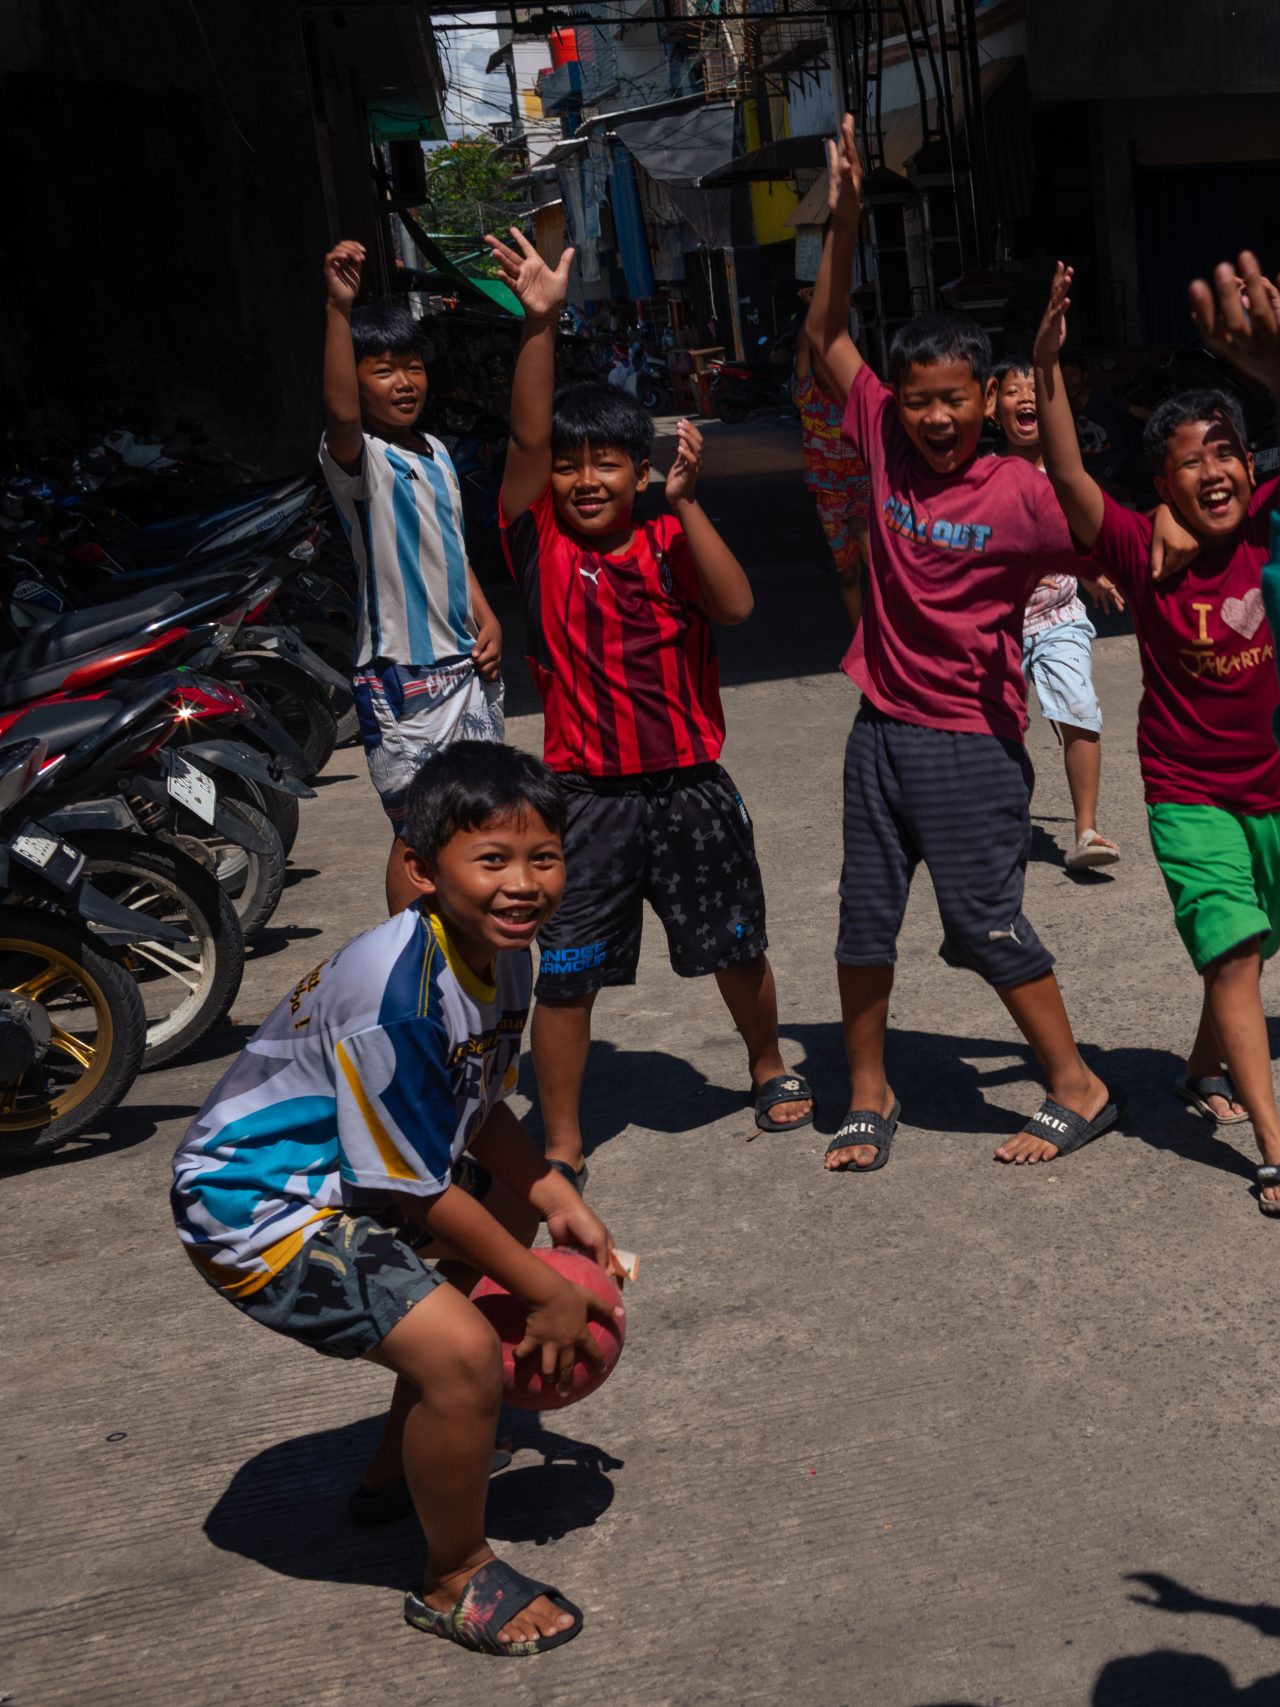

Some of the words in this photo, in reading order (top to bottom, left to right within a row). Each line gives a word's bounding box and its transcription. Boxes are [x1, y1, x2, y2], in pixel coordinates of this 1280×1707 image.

[931, 519, 992, 554] OUT
[1191, 602, 1214, 646] I
[1178, 643, 1273, 678] JAKARTA
